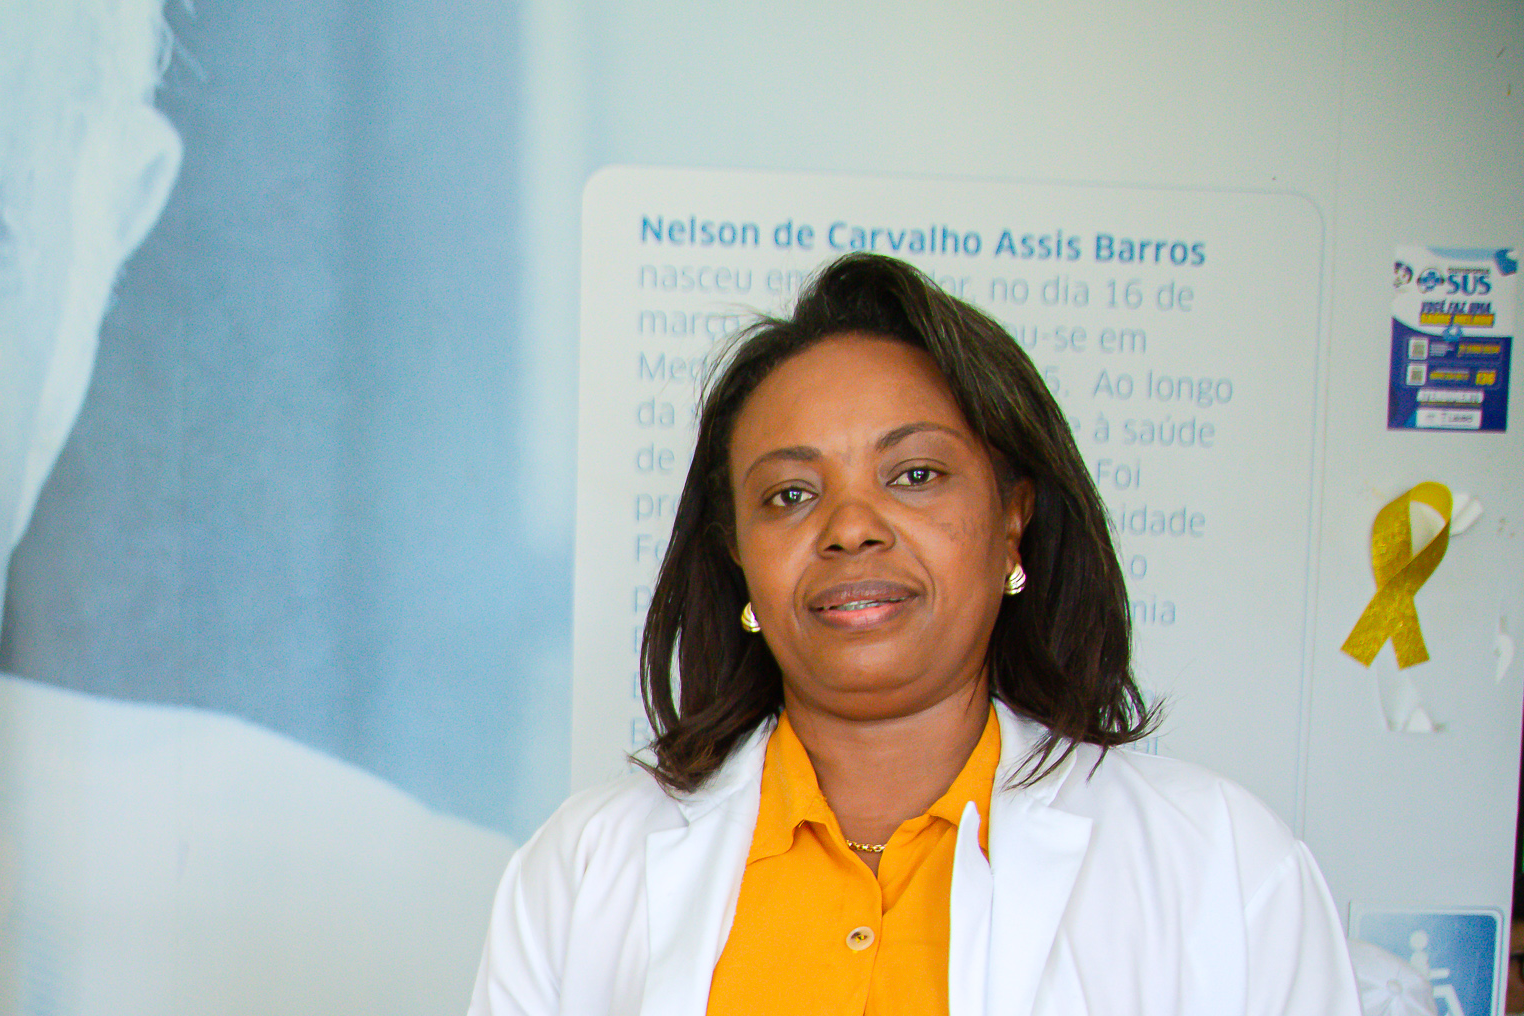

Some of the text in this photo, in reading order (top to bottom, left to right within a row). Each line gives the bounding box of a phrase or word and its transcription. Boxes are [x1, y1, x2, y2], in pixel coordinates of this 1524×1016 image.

[641, 214, 1207, 267] Nelson de Carvalho Assis Barros
[640, 264, 753, 293] nasceu
[990, 275, 1029, 306] no
[1040, 274, 1090, 308] dia
[1107, 278, 1144, 310] 16
[1156, 280, 1195, 313] de
[1446, 274, 1492, 297] SUS
[639, 309, 742, 345] março
[1099, 327, 1148, 355] em
[1093, 369, 1134, 400] Ao
[1148, 369, 1233, 409] longo
[637, 397, 675, 427] da
[1124, 414, 1216, 449] saúde
[636, 442, 1142, 490] de Foi
[1120, 502, 1206, 538] idade
